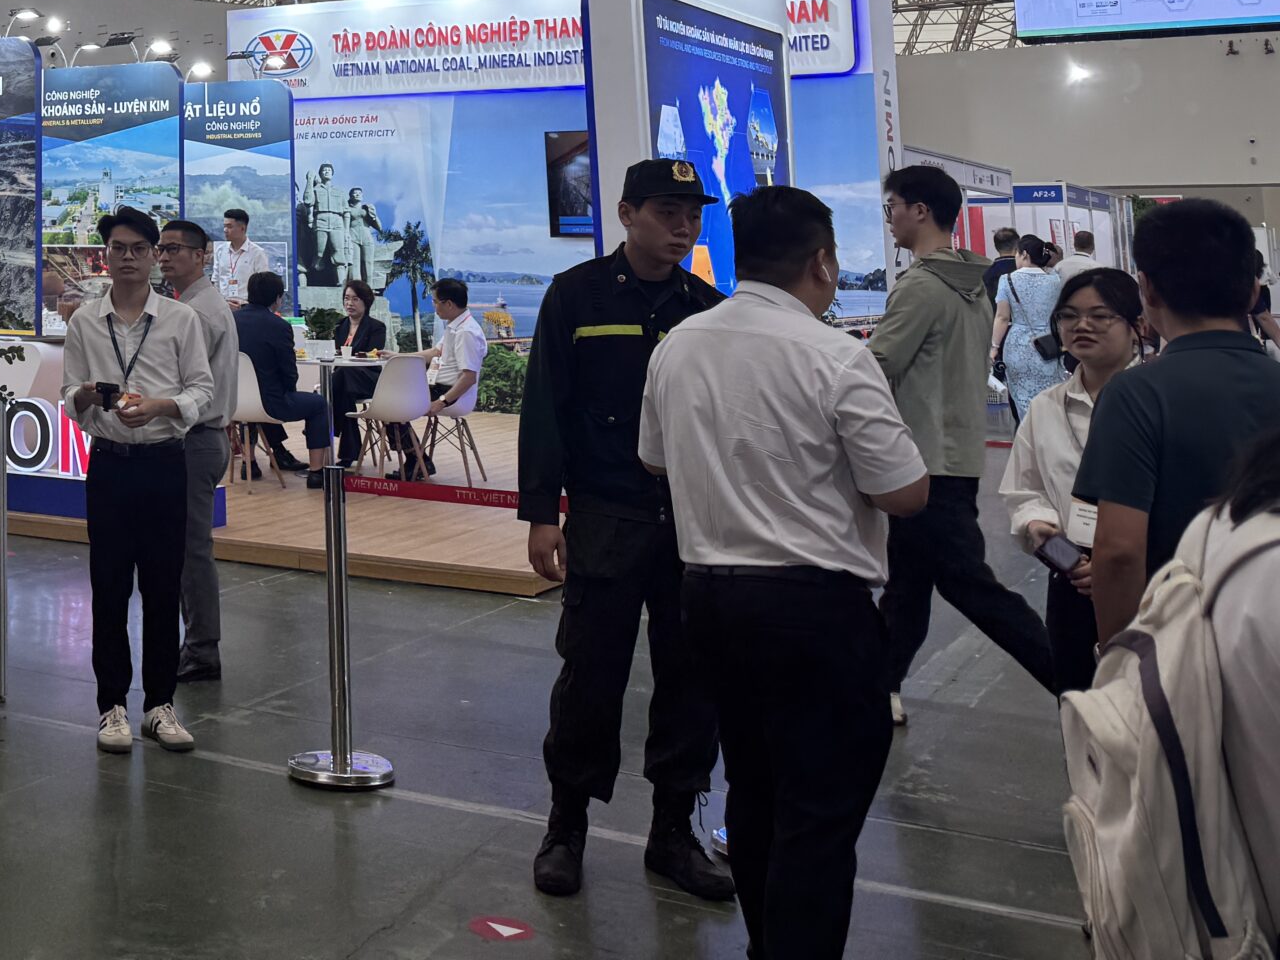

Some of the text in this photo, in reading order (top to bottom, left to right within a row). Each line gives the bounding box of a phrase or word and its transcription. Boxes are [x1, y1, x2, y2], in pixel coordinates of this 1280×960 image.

[332, 15, 583, 58] TẬP ĐOÀN CÔNG NGHIỆP THAN
[788, 34, 830, 52] MITED
[332, 60, 381, 78] VIETNAM
[385, 58, 440, 75] NATIONAL
[442, 56, 472, 72] COAL
[533, 50, 584, 68] INDUSTR
[46, 88, 100, 100] CÔNG NGHIỆP
[42, 102, 82, 117] KHOÁNG
[84, 100, 105, 115] SẢN
[114, 99, 147, 116] LUYỆN
[150, 100, 170, 112] KIM
[184, 97, 261, 120] ẬT LIỆU NỔ
[206, 120, 261, 131] CÔNG NGHIỆP
[318, 116, 330, 125] VÀ
[310, 129, 396, 139] AND CONCENTRICITY
[1032, 190, 1056, 198] AF2-5
[350, 478, 370, 490] VIET
[374, 481, 398, 492] NAM
[482, 492, 506, 504] VIET
